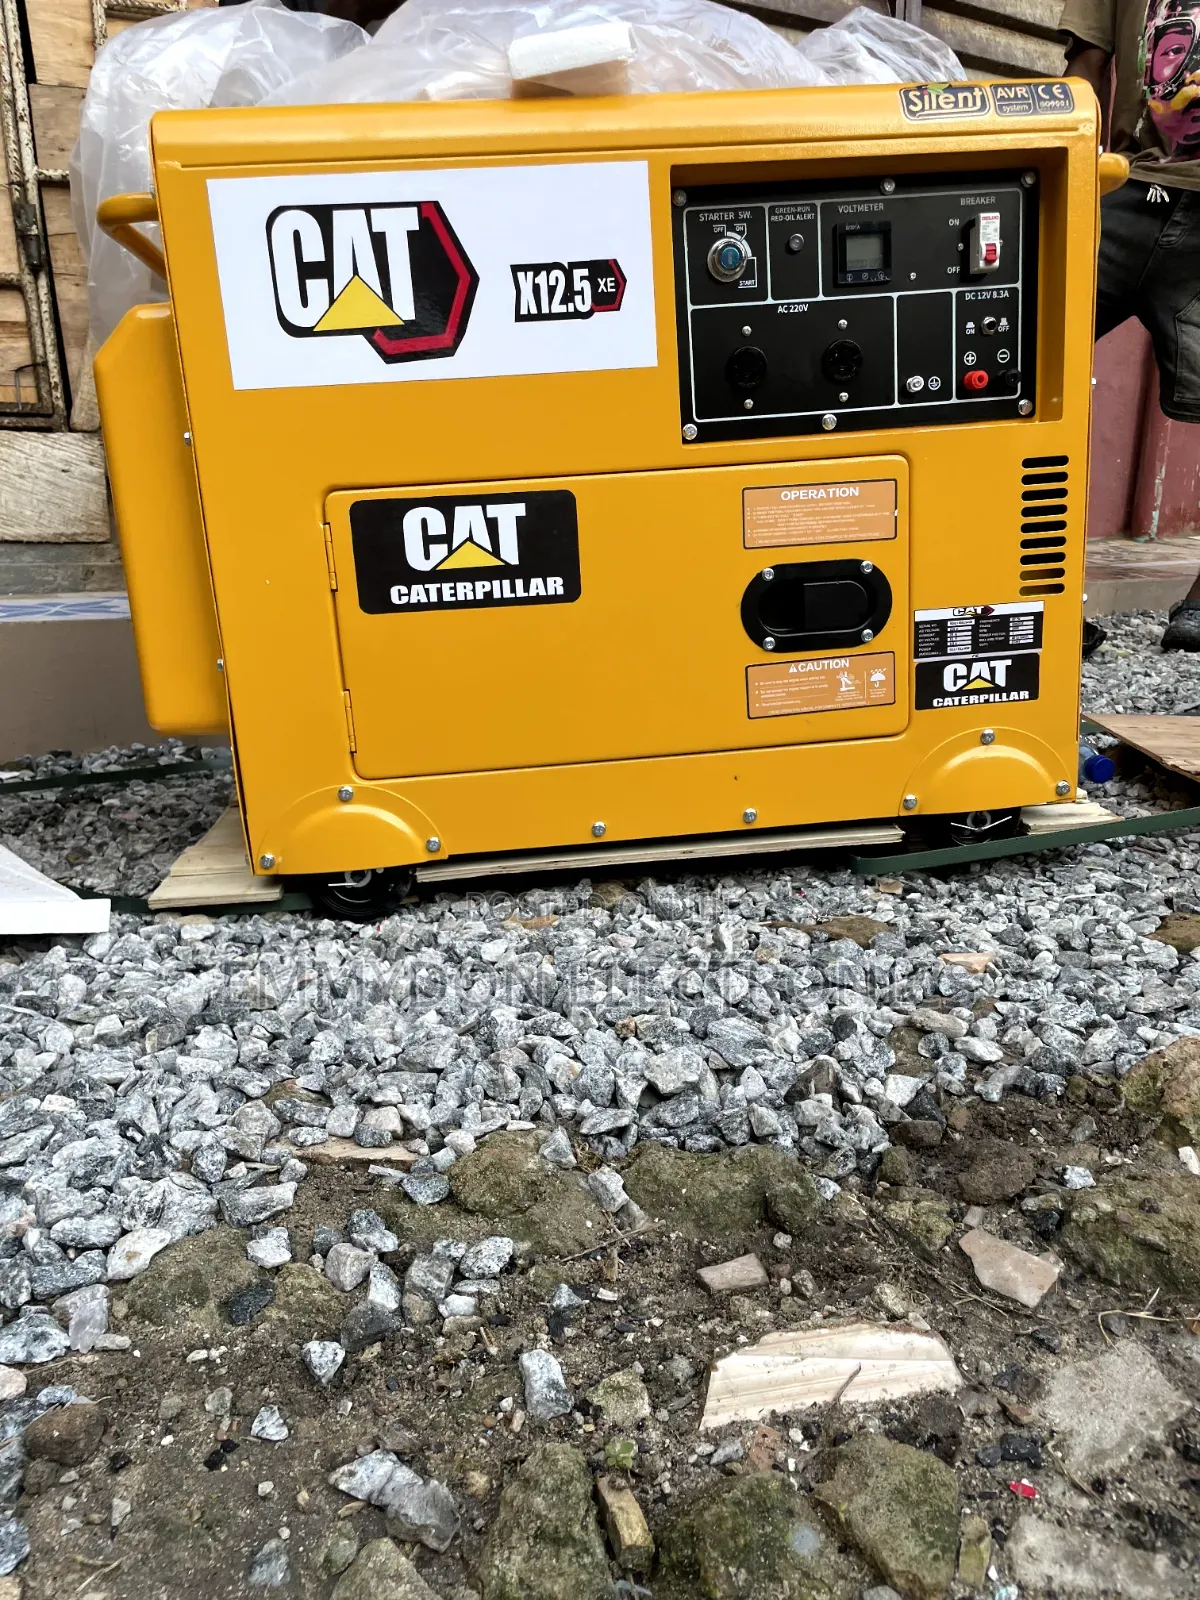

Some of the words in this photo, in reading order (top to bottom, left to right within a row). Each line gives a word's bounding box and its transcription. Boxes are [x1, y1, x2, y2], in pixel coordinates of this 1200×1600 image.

[996, 86, 1029, 99] AVR
[908, 87, 983, 112] Silent
[1002, 104, 1029, 113] system
[960, 196, 996, 206] BREAKER
[774, 206, 811, 214] GREEN-RUN
[838, 203, 885, 214] VOLTMETER
[699, 212, 735, 222] STARTER
[738, 211, 753, 219] SW.
[796, 213, 815, 221] ALERT
[948, 218, 960, 227] ON
[271, 206, 420, 328] CAT
[946, 266, 961, 275] OFF
[517, 267, 593, 316] X12.5
[597, 277, 617, 293] XE
[965, 292, 976, 301] DC
[977, 291, 992, 300] 12V
[992, 290, 1009, 299] 8.3A
[777, 305, 788, 314] AC
[789, 303, 809, 313] 220V
[997, 325, 1010, 333] OFF
[780, 486, 860, 501] OPERATION
[402, 502, 527, 572] CAT
[389, 576, 565, 605] CATERPILLAR
[953, 605, 985, 616] CAT
[798, 658, 850, 672] CAUTION
[943, 659, 1013, 692] CAT
[932, 690, 1030, 707] CATERPILLAR
